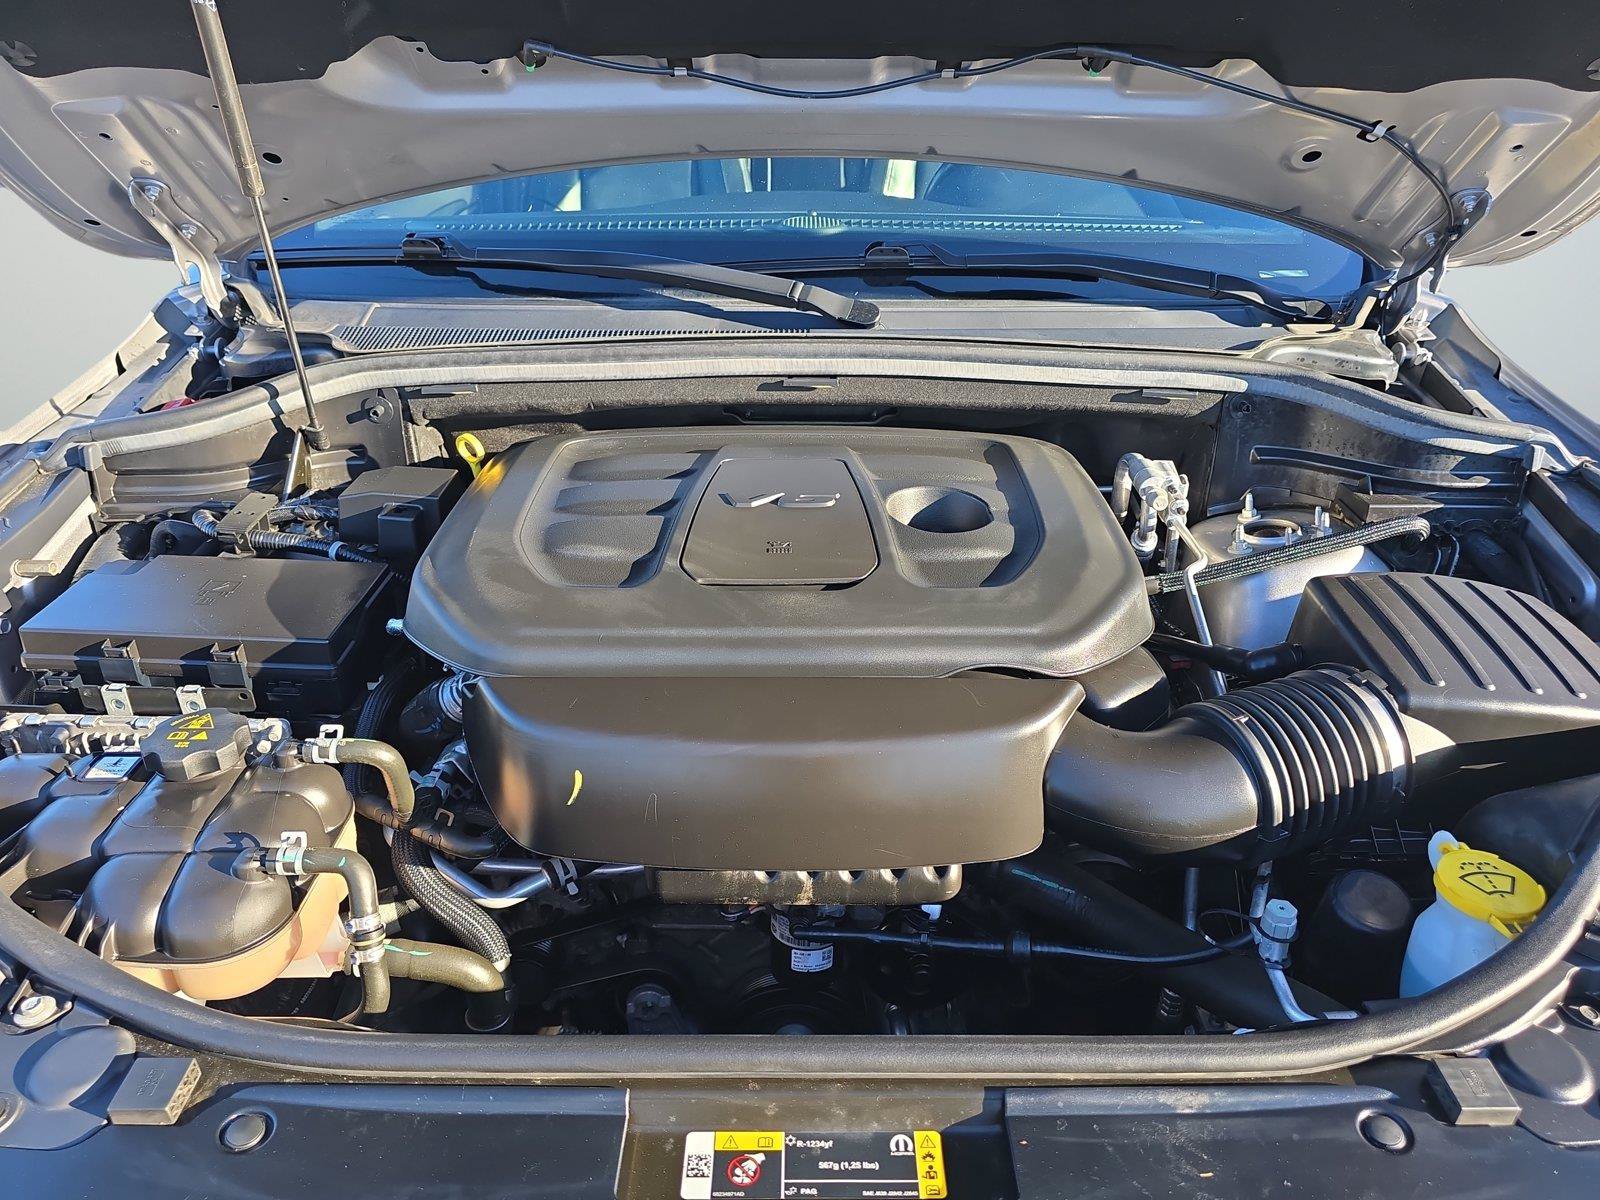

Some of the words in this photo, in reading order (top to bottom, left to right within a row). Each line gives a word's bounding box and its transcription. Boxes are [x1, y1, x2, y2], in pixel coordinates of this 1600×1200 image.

[797, 1139, 834, 1149] R-1234yf
[818, 1161, 839, 1171] 567g
[840, 1161, 861, 1171] (1,25
[862, 1161, 880, 1171] lbs)
[800, 1187, 818, 1196] PAG
